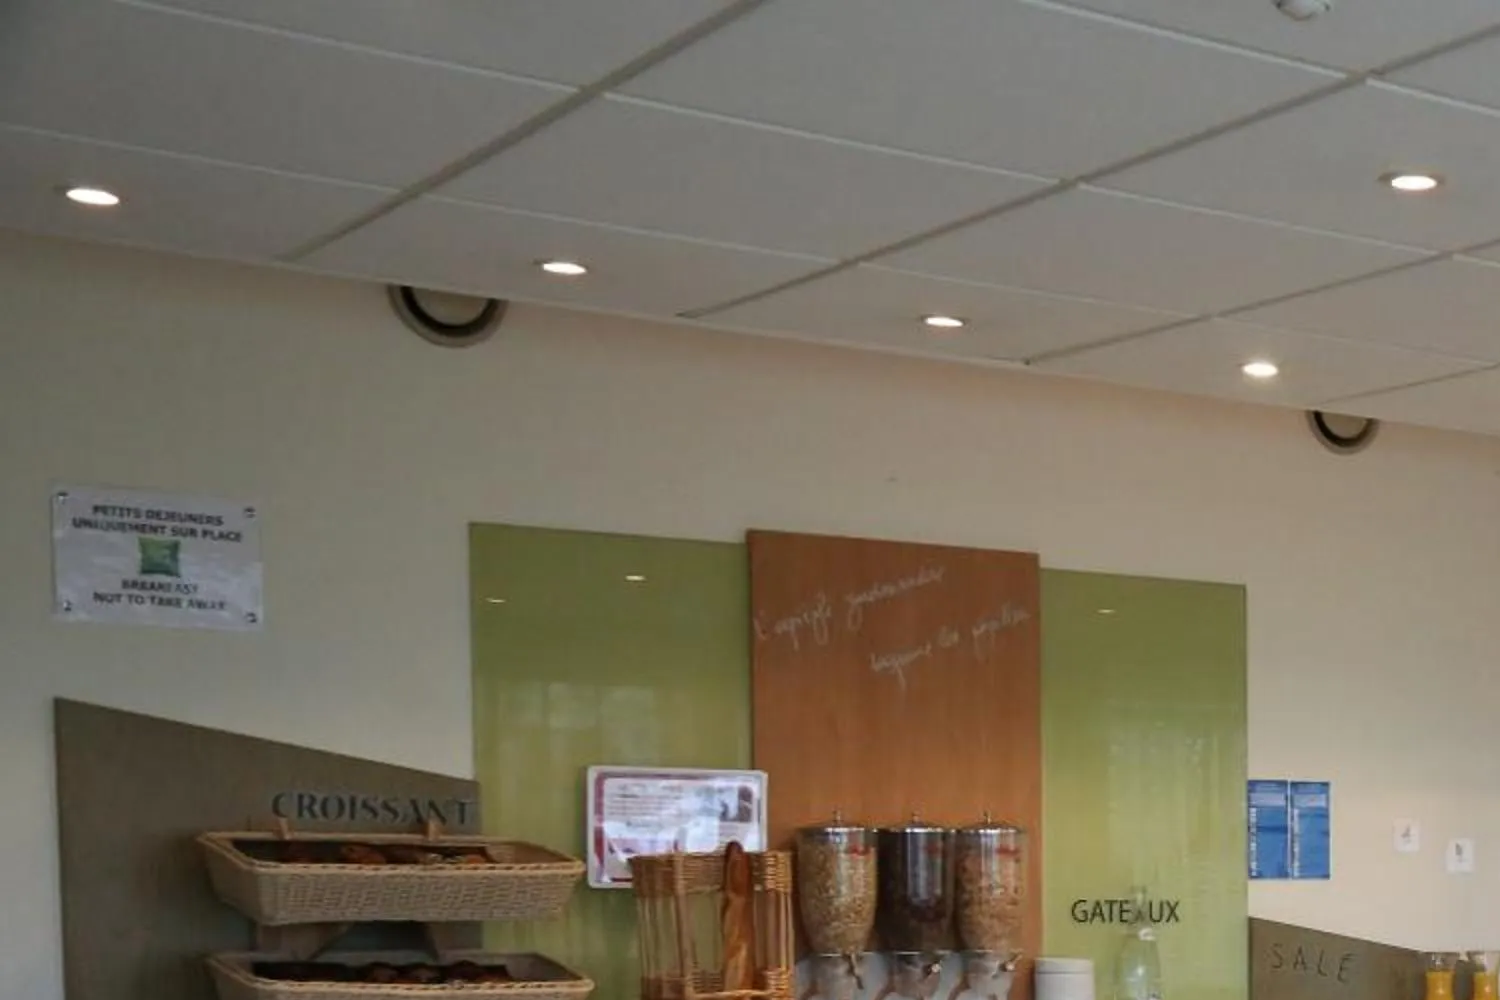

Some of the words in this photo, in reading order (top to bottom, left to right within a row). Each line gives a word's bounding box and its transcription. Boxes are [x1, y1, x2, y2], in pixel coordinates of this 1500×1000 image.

[92, 504, 142, 519] PETITS
[72, 516, 166, 536] UNIQUEMENT
[171, 525, 198, 539] SUR
[201, 527, 242, 543] PLACE
[92, 591, 122, 605] NOT
[127, 592, 145, 606] TO
[271, 791, 473, 826] CROISSANT
